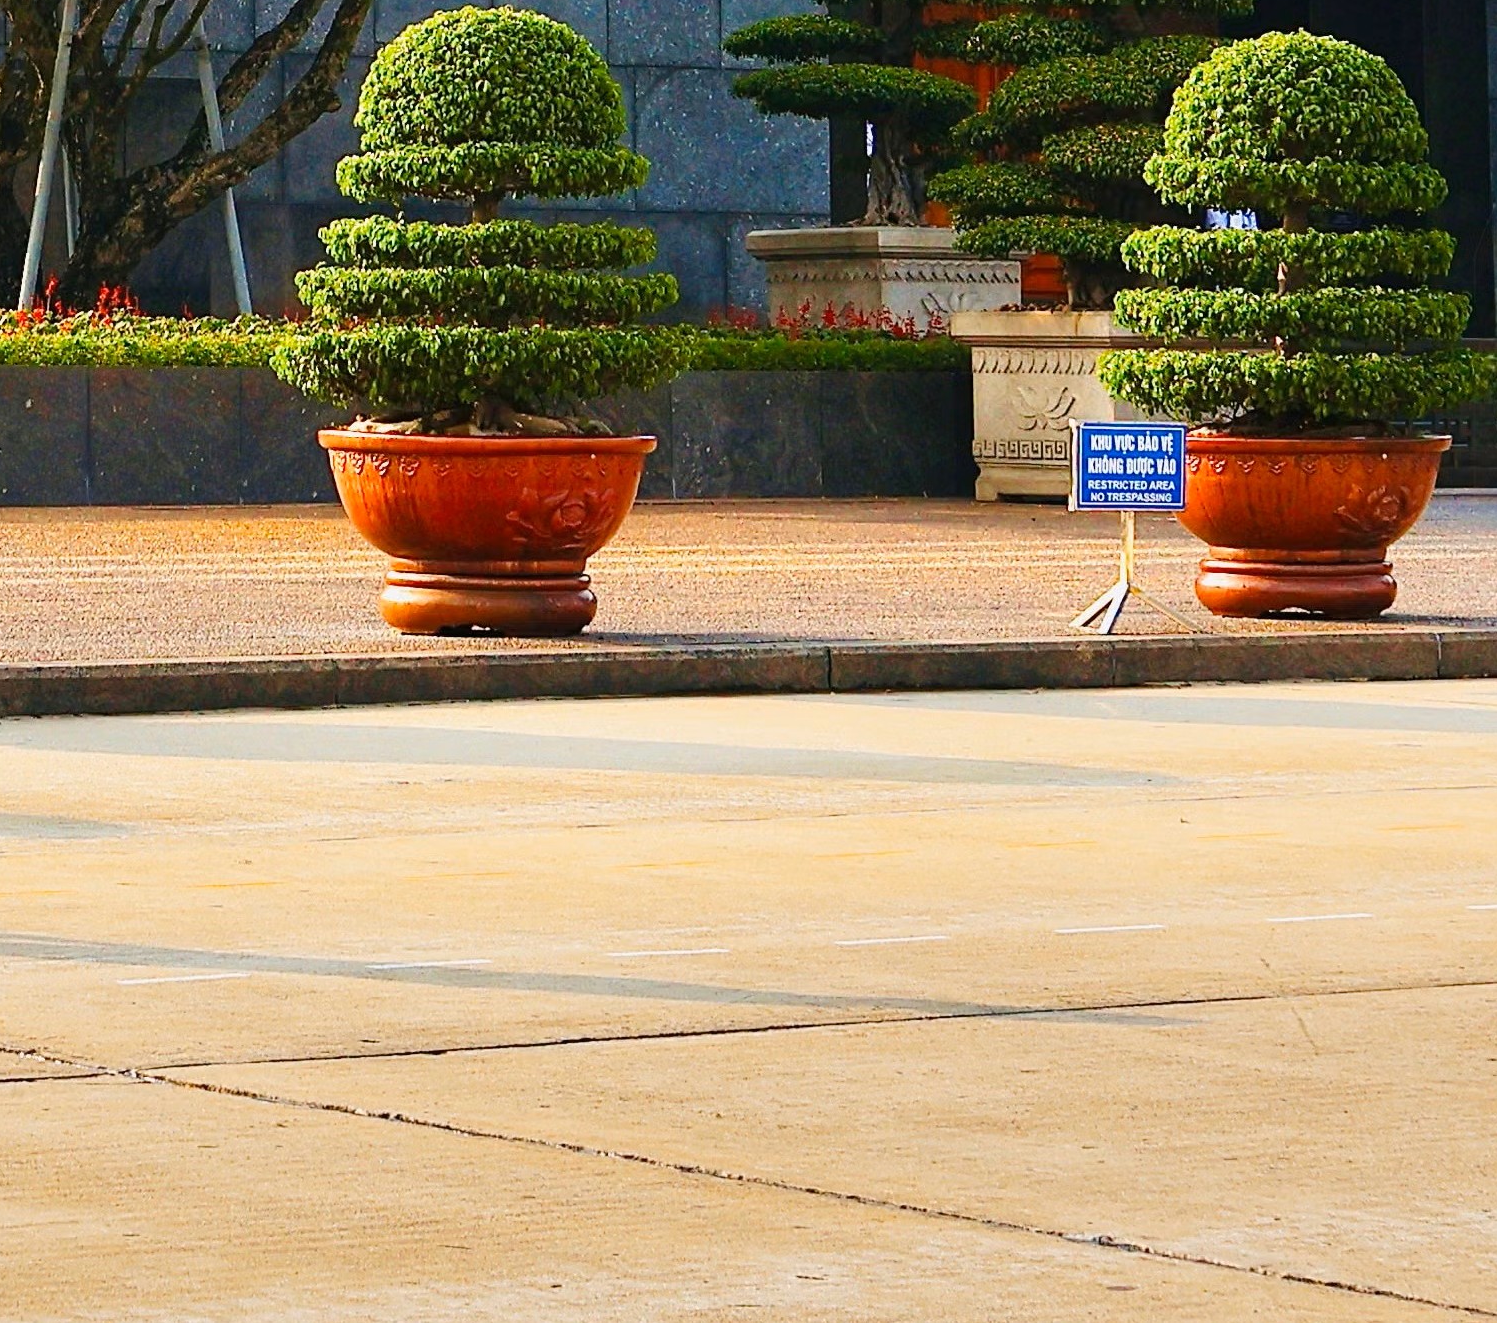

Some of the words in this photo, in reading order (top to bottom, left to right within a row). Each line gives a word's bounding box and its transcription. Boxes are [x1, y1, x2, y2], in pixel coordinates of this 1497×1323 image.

[1090, 434, 1112, 451] KHU
[1160, 433, 1173, 455] VỆ
[1087, 454, 1124, 474] KHÔNG
[1156, 455, 1177, 475] VÀO
[1087, 480, 1148, 490] RESTRICTED
[1149, 480, 1175, 490] AREA
[1090, 492, 1105, 502] NO
[1107, 492, 1172, 502] TRESPASSING
